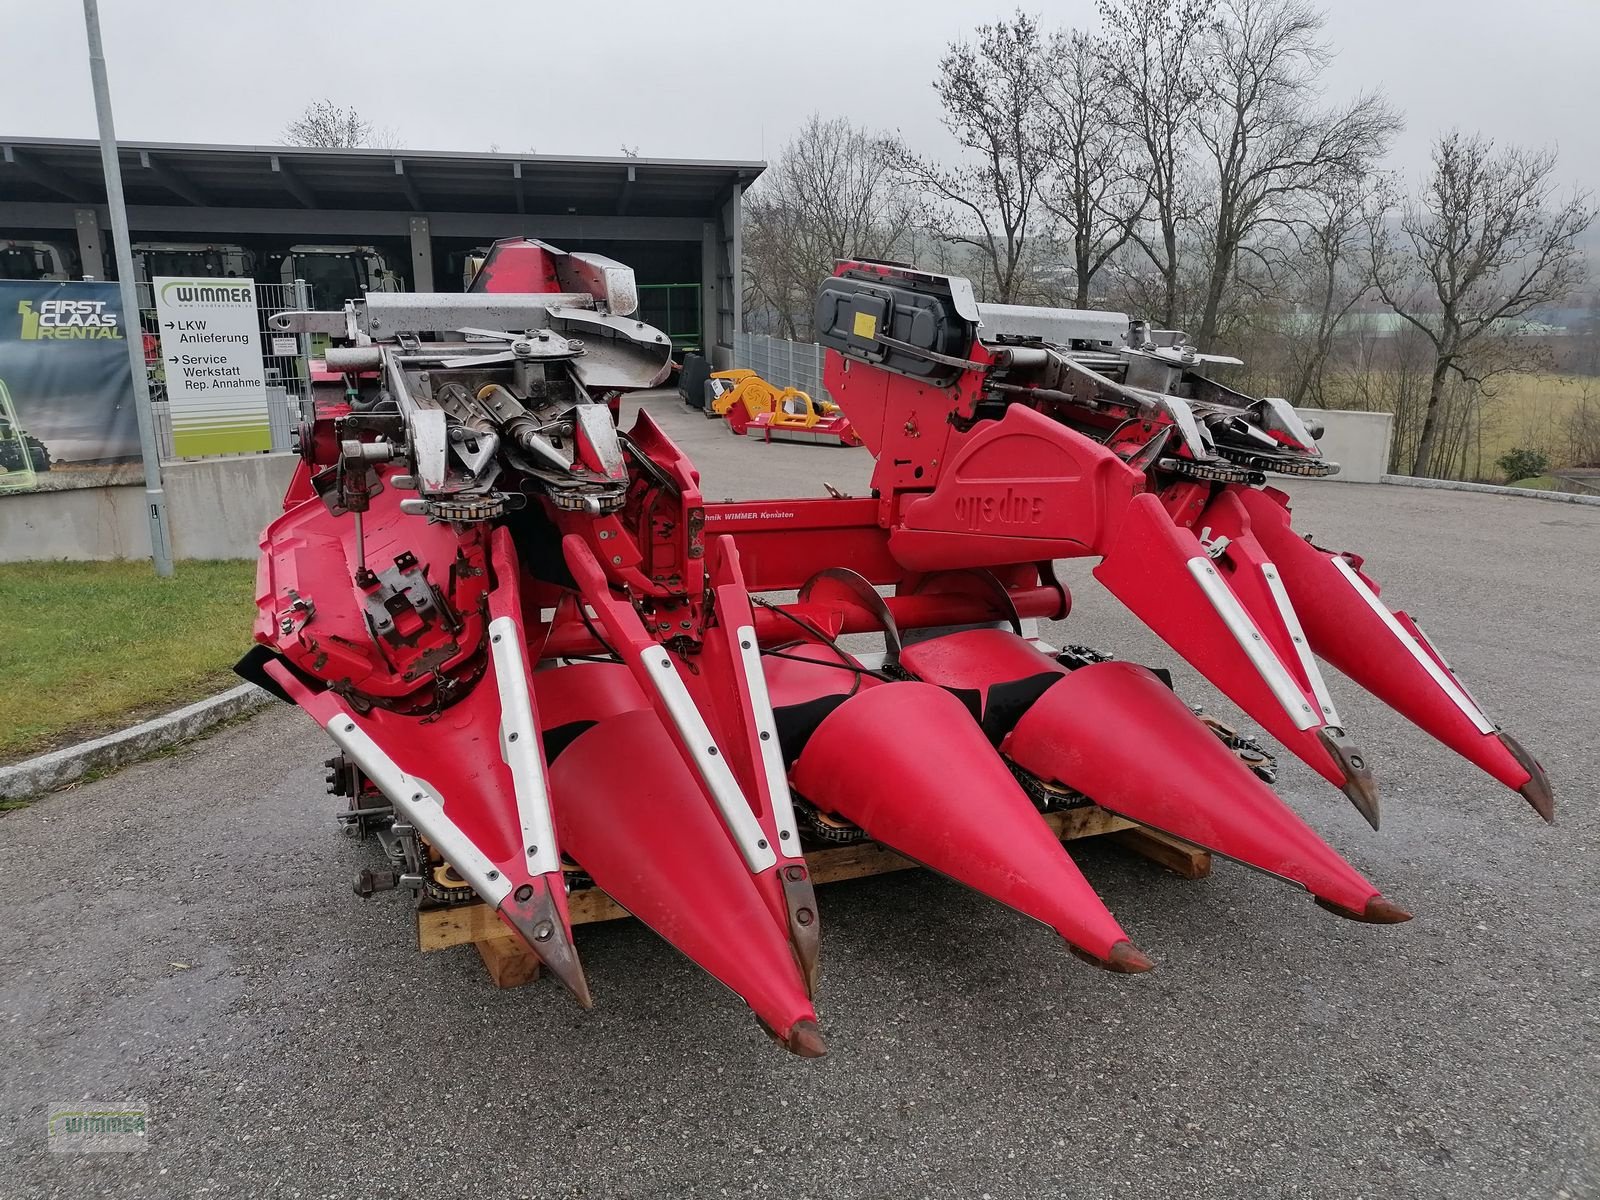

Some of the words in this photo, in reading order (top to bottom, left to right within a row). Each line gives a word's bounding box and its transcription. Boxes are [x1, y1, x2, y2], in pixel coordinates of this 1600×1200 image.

[176, 287, 252, 302] WIMMER
[40, 300, 107, 314] FIRST
[39, 313, 117, 327] CLAAS
[178, 320, 207, 331] LKW
[38, 326, 124, 340] RENTAL
[179, 333, 249, 345] Anlieferung
[182, 354, 227, 365] Service
[183, 366, 241, 377] Werkstatt
[185, 379, 209, 391] Rep.
[212, 377, 261, 389] Annahme
[724, 511, 758, 520] WIMMER
